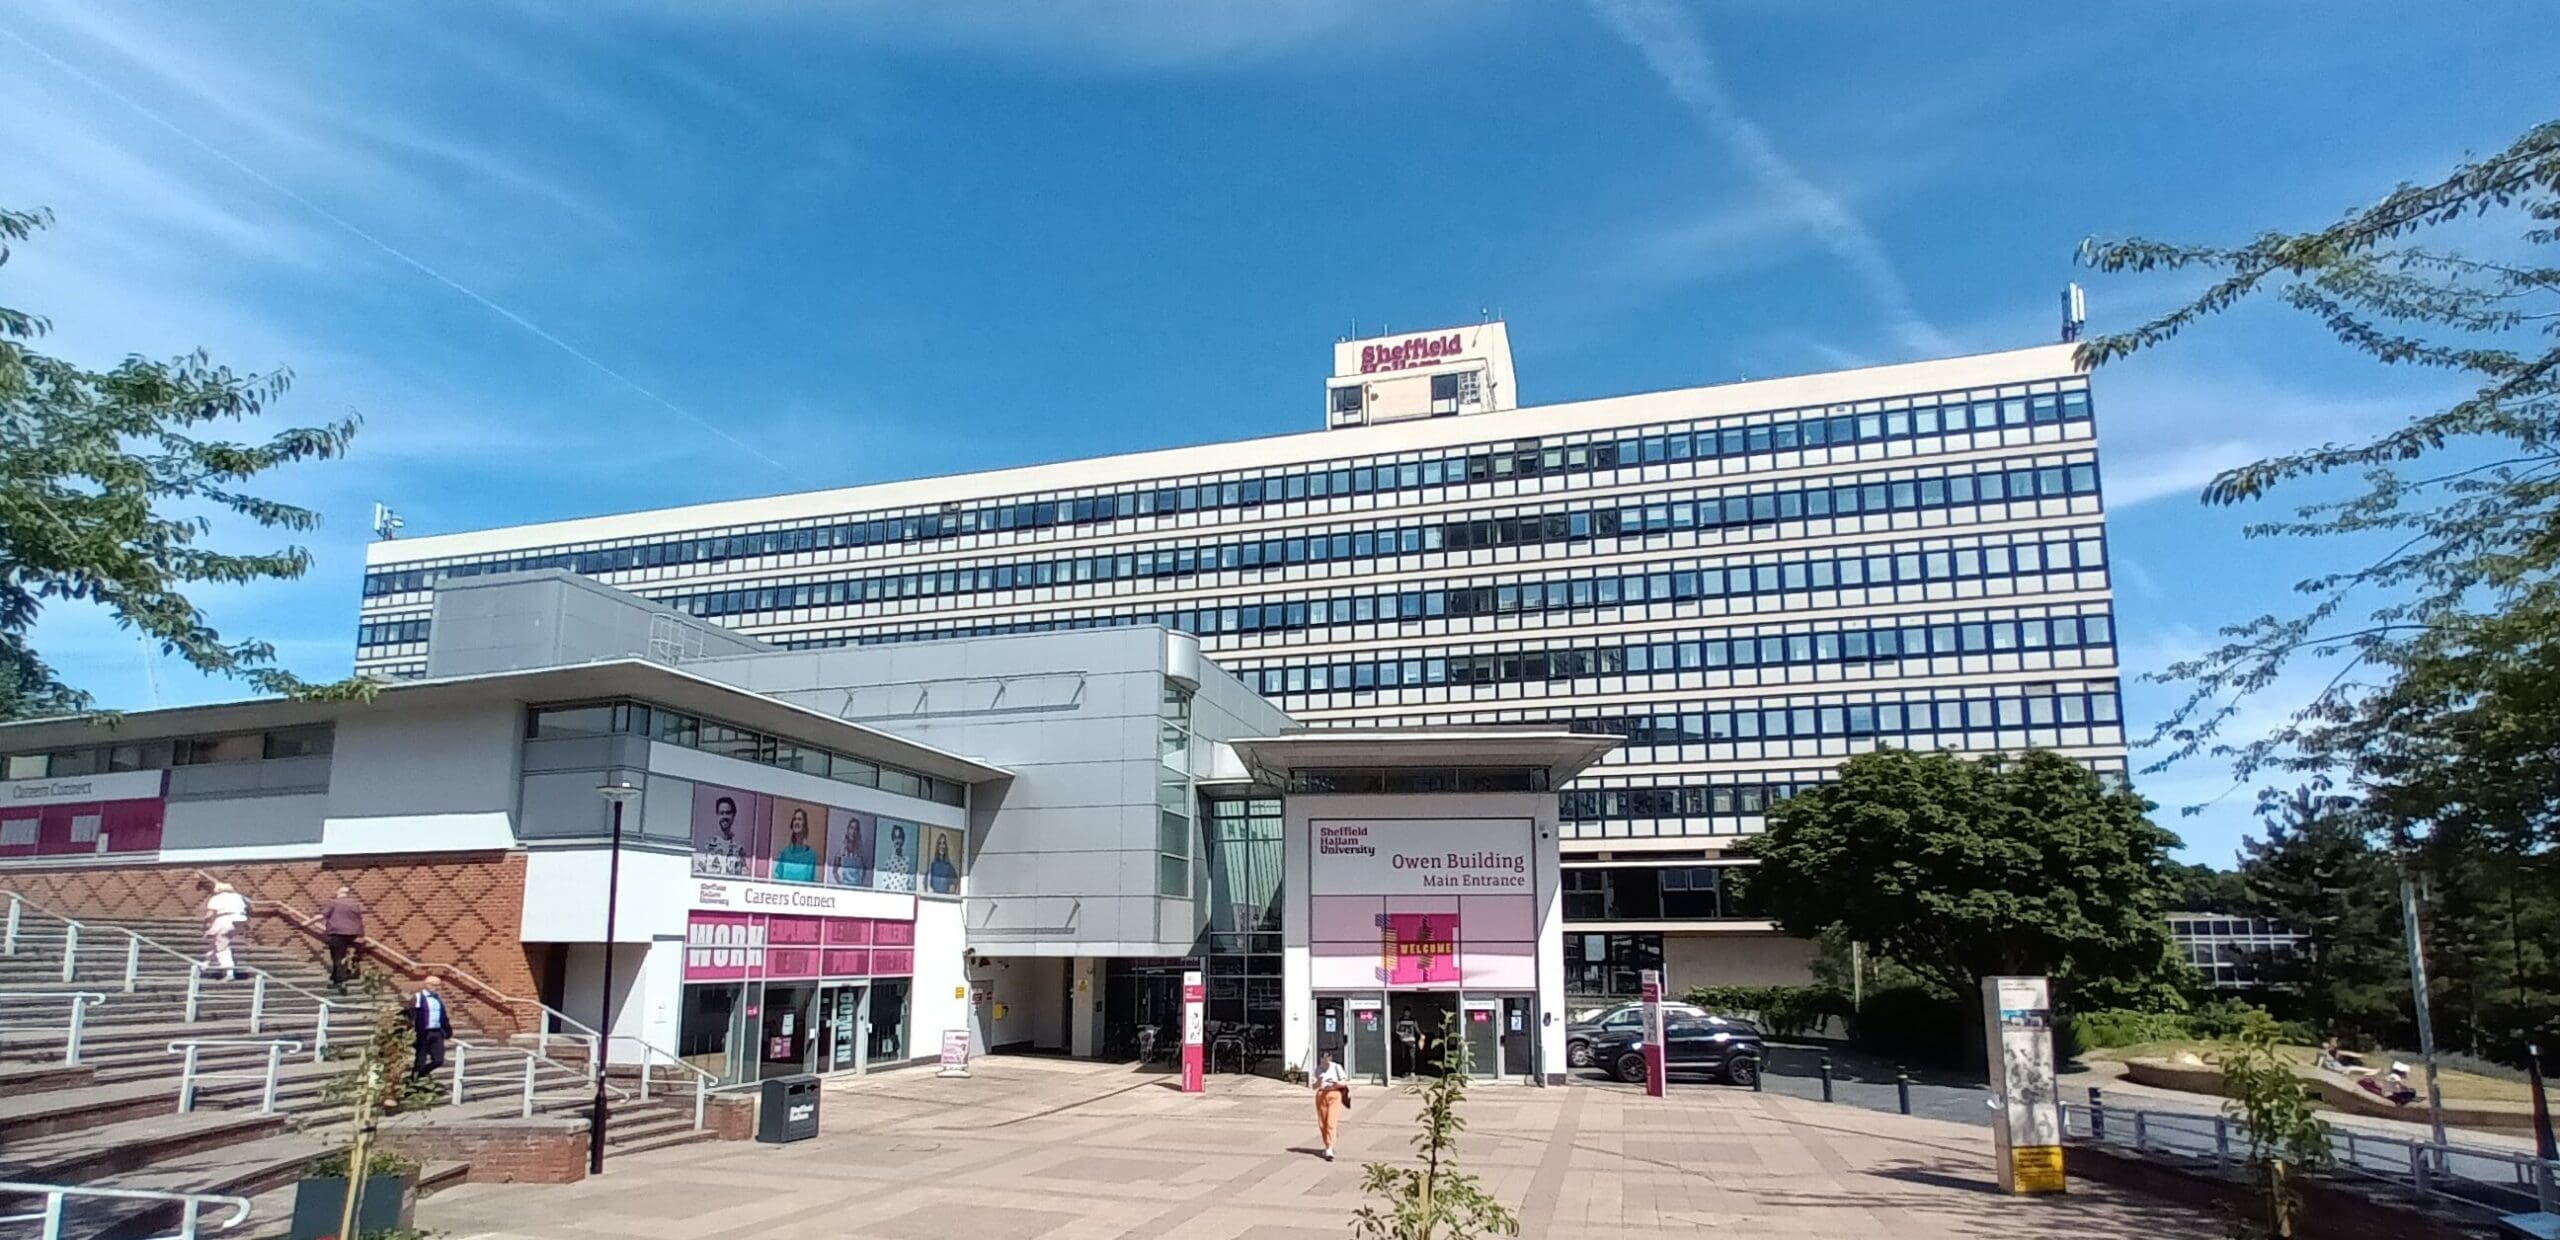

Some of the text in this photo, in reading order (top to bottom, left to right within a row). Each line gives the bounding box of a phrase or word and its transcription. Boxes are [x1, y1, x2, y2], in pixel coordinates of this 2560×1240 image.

[1362, 334, 1462, 362] Sheffield
[1320, 827, 1368, 836] Sheffield
[1320, 836, 1359, 846] Hallam
[1320, 845, 1375, 857] University
[1392, 852, 1525, 872] Owen Building
[1423, 874, 1525, 887] Main Entrance
[744, 888, 836, 908] Careers Connect
[688, 923, 764, 967] WORK
[1400, 943, 1451, 954] WELCOME
